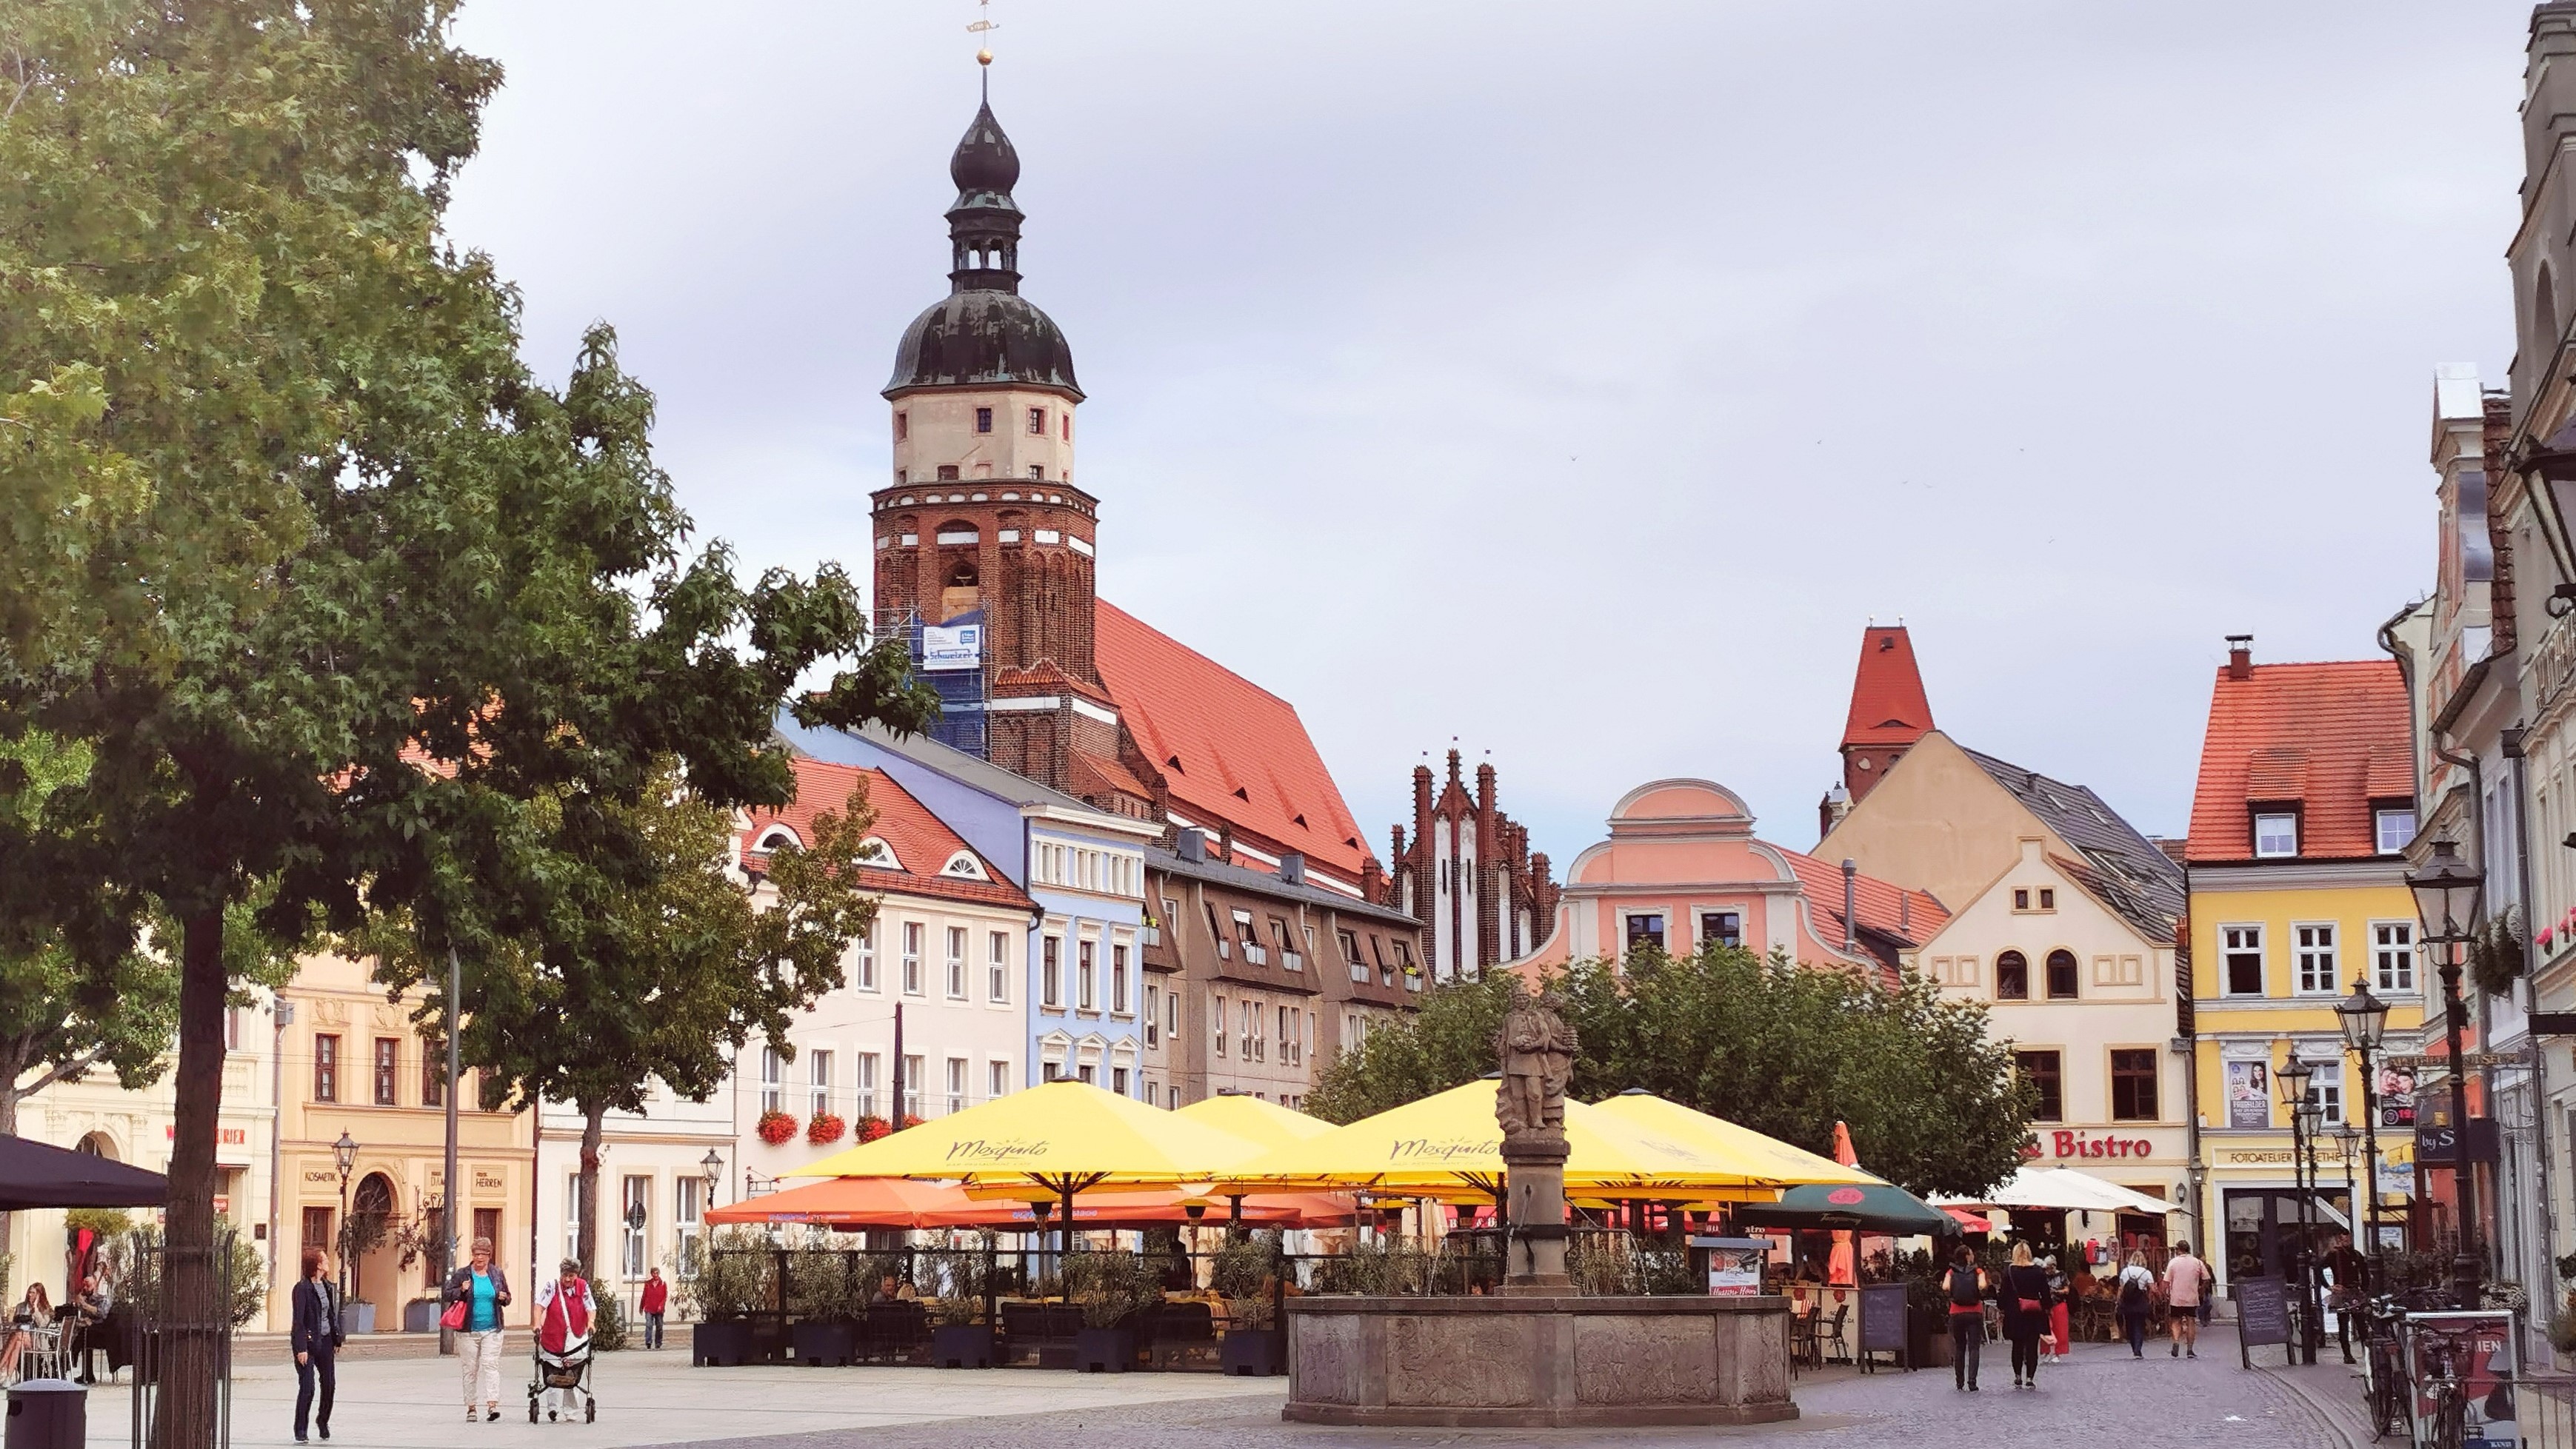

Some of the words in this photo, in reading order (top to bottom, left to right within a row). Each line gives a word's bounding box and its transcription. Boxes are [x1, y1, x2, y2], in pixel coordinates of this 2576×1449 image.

[1389, 1140, 1499, 1160] Mosquito
[2052, 1130, 2152, 1158] Bistro
[2422, 1134, 2437, 1150] by
[946, 1140, 1050, 1161] Mosquito
[2231, 1153, 2292, 1162] FOTOATELIER
[304, 1172, 337, 1182] KOSMETIK
[476, 1178, 502, 1188] HERREN
